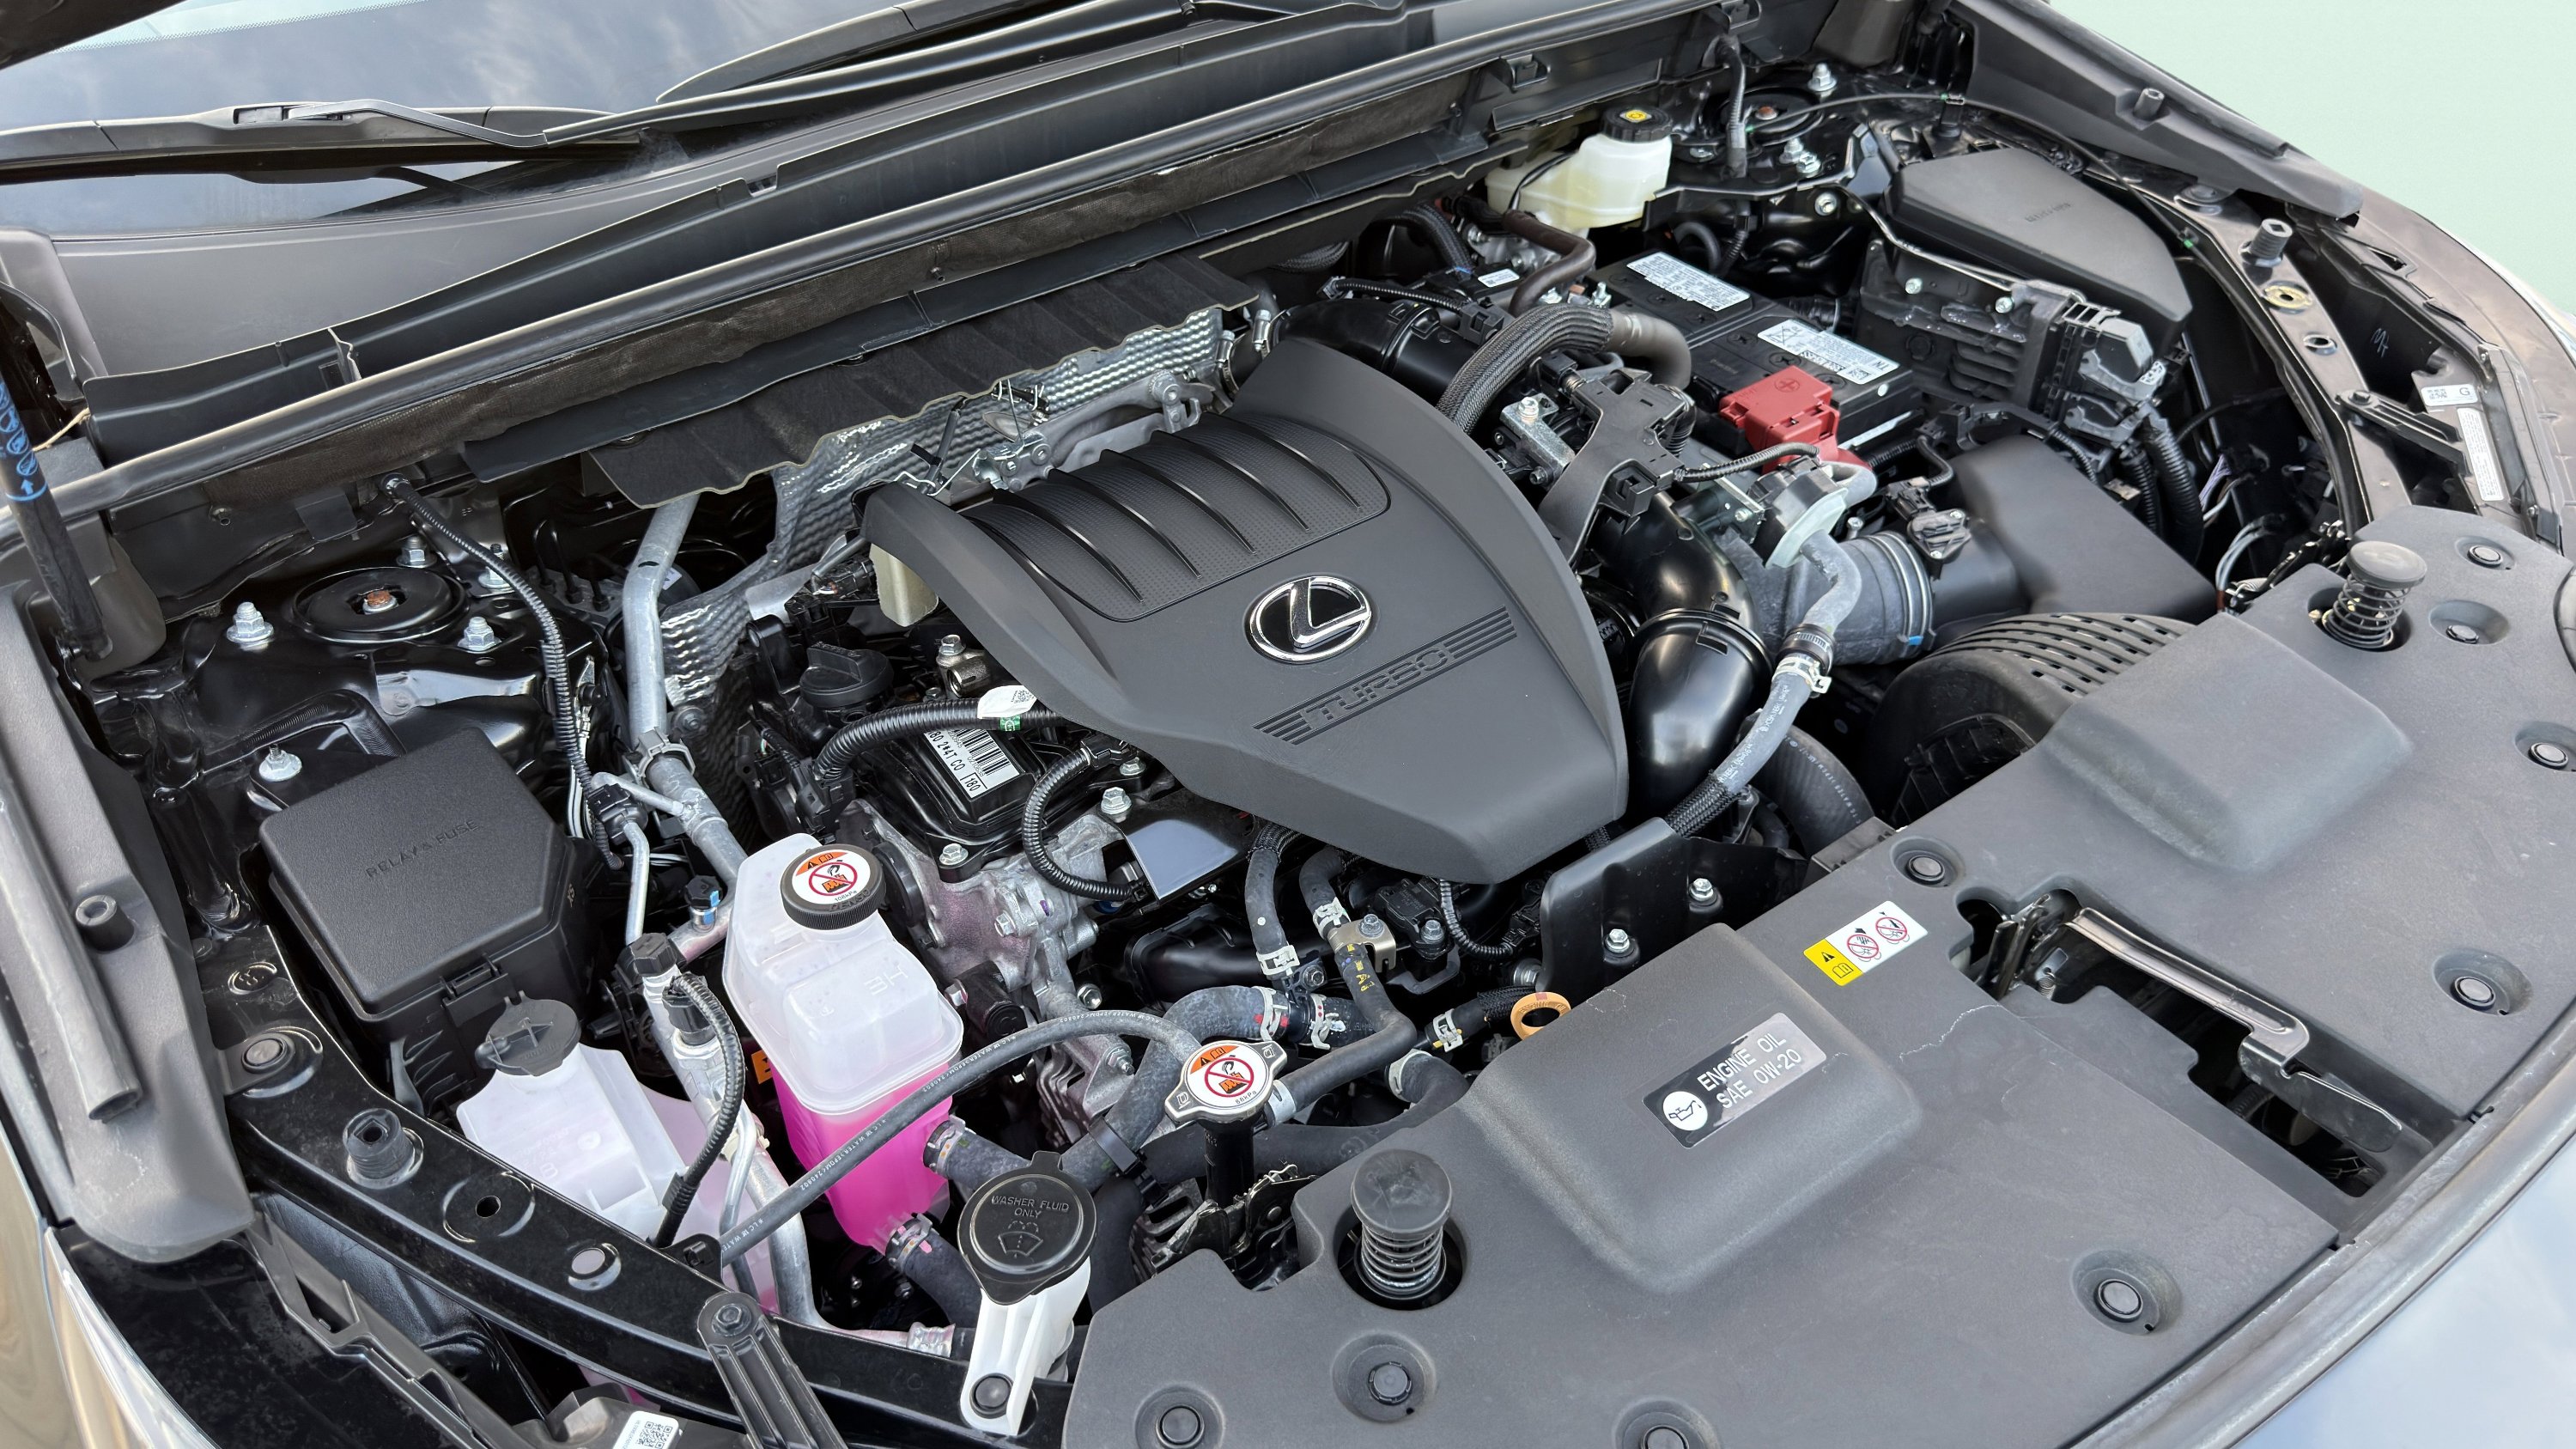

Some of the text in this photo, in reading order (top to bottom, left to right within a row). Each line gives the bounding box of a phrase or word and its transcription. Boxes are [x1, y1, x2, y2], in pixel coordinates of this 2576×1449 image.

[2459, 387, 2470, 396] G
[1304, 646, 1449, 721] TURBO
[950, 759, 966, 771] CO
[964, 777, 981, 792] 180
[365, 845, 418, 878] RELAY
[434, 819, 480, 845] FUSE
[829, 889, 871, 911] DENSO
[834, 890, 857, 903] 108kPa
[1697, 1032, 1787, 1093] ENGINE OIL
[1716, 1047, 1802, 1109] SAE 0W-20
[1235, 1089, 1258, 1105] 88kPa
[991, 1195, 1070, 1213] WASHER FLUID
[1014, 1207, 1042, 1220] ONLY
